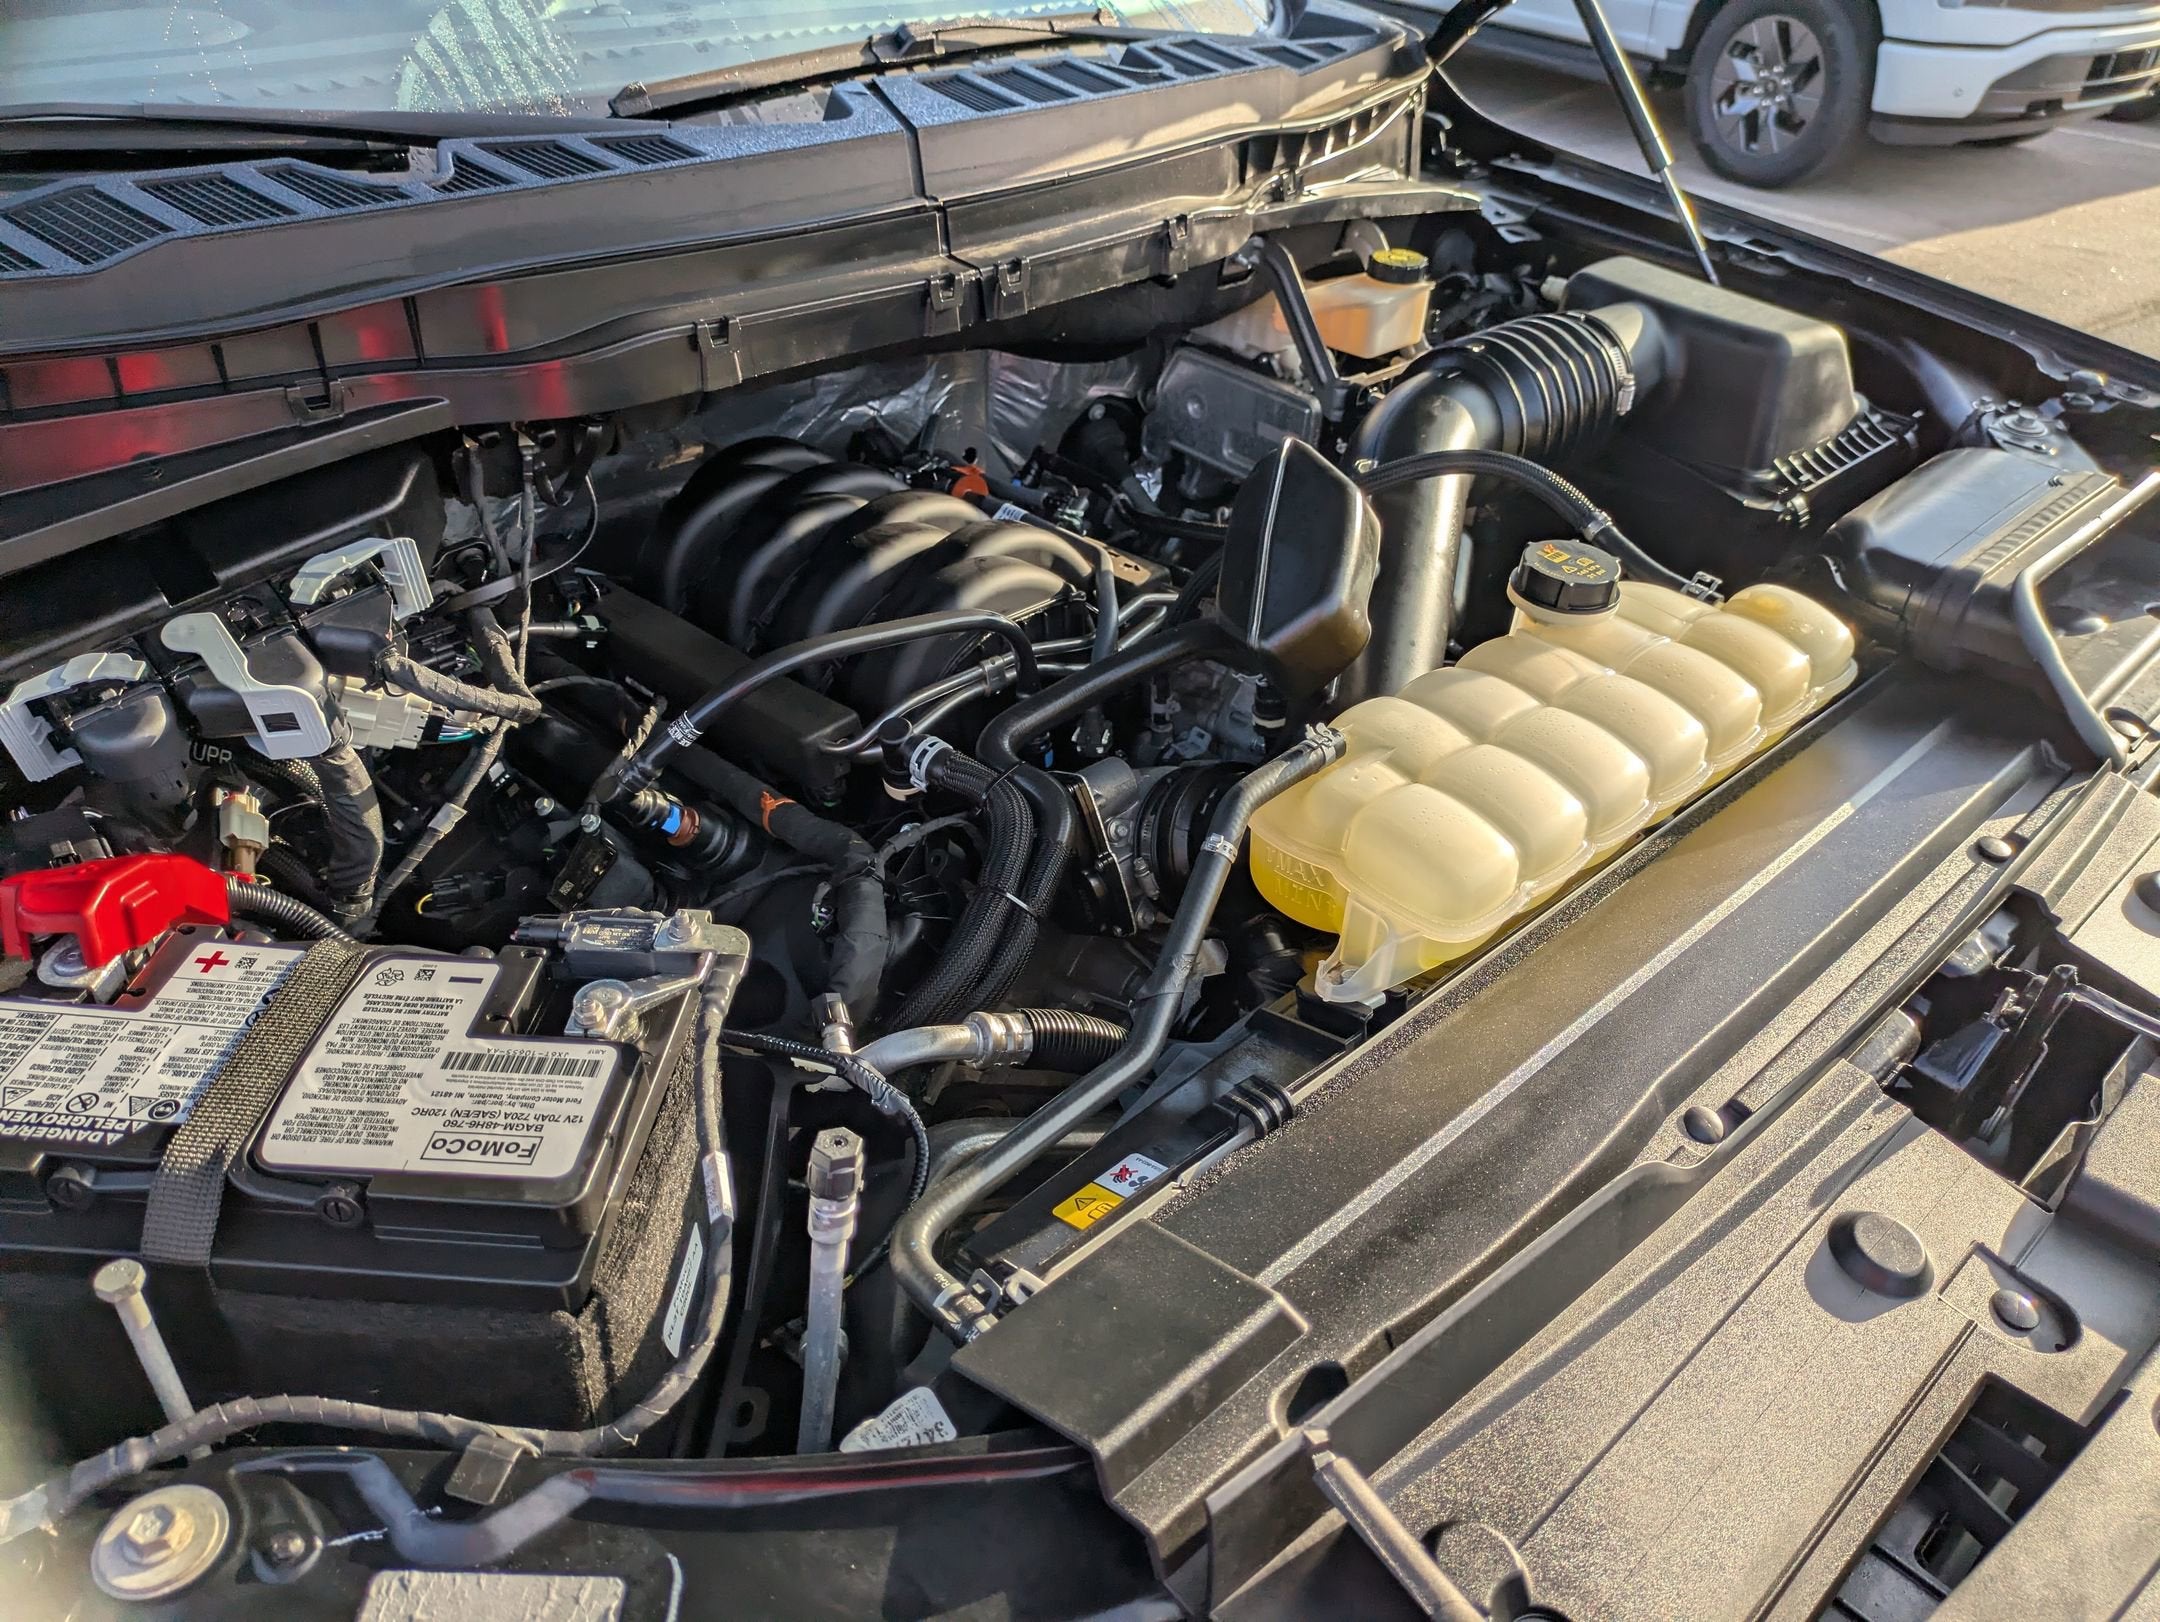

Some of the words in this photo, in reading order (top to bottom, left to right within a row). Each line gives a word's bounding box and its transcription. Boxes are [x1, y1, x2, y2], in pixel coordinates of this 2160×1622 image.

[1276, 852, 1325, 887] MAX
[1274, 878, 1322, 911] MIN
[386, 1051, 435, 1059] AVERTISSEMENT
[352, 1075, 398, 1083] RECOMENDADO
[357, 1082, 392, 1090] DESMONTE
[465, 1092, 503, 1100] Dearborn,
[355, 1109, 390, 1117] CHARGING
[409, 1107, 448, 1116] 120RC
[449, 1107, 502, 1119] (SAE/EN)
[501, 1111, 530, 1120] 720A
[293, 1112, 321, 1120] PROPER
[531, 1113, 561, 1122] 70Ah
[563, 1114, 585, 1122] 12V
[295, 1120, 346, 1128] RECOMMENDED
[441, 1118, 544, 1132] BAGM-48H6-760
[293, 1127, 340, 1135] DISASSEMBLE
[280, 1134, 318, 1142] EXPLOSION
[361, 1138, 394, 1146] WARNING:
[431, 1137, 537, 1158] FoMoCo
